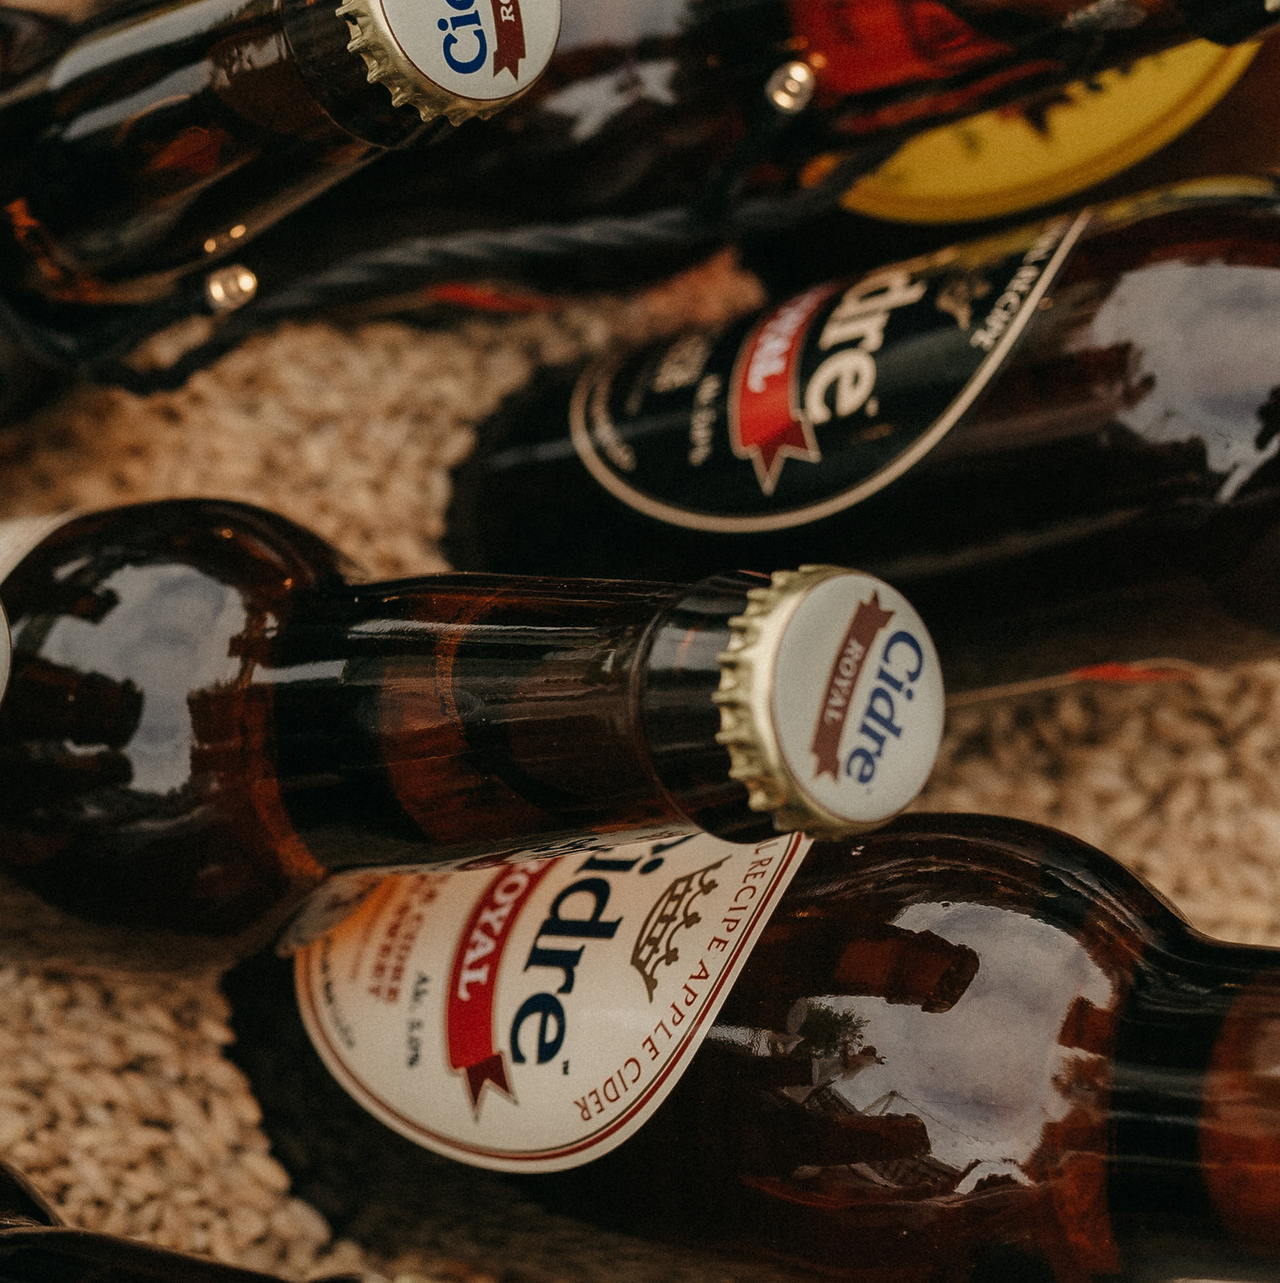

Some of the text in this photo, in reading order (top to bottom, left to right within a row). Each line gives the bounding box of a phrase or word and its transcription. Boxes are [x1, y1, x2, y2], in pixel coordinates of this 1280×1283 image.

[804, 266, 927, 425] dre
[822, 637, 867, 725] ROYAL
[846, 630, 923, 784] Cidre
[509, 838, 675, 1066] idre
[572, 856, 775, 1122] RECIPE APPLE CIDER
